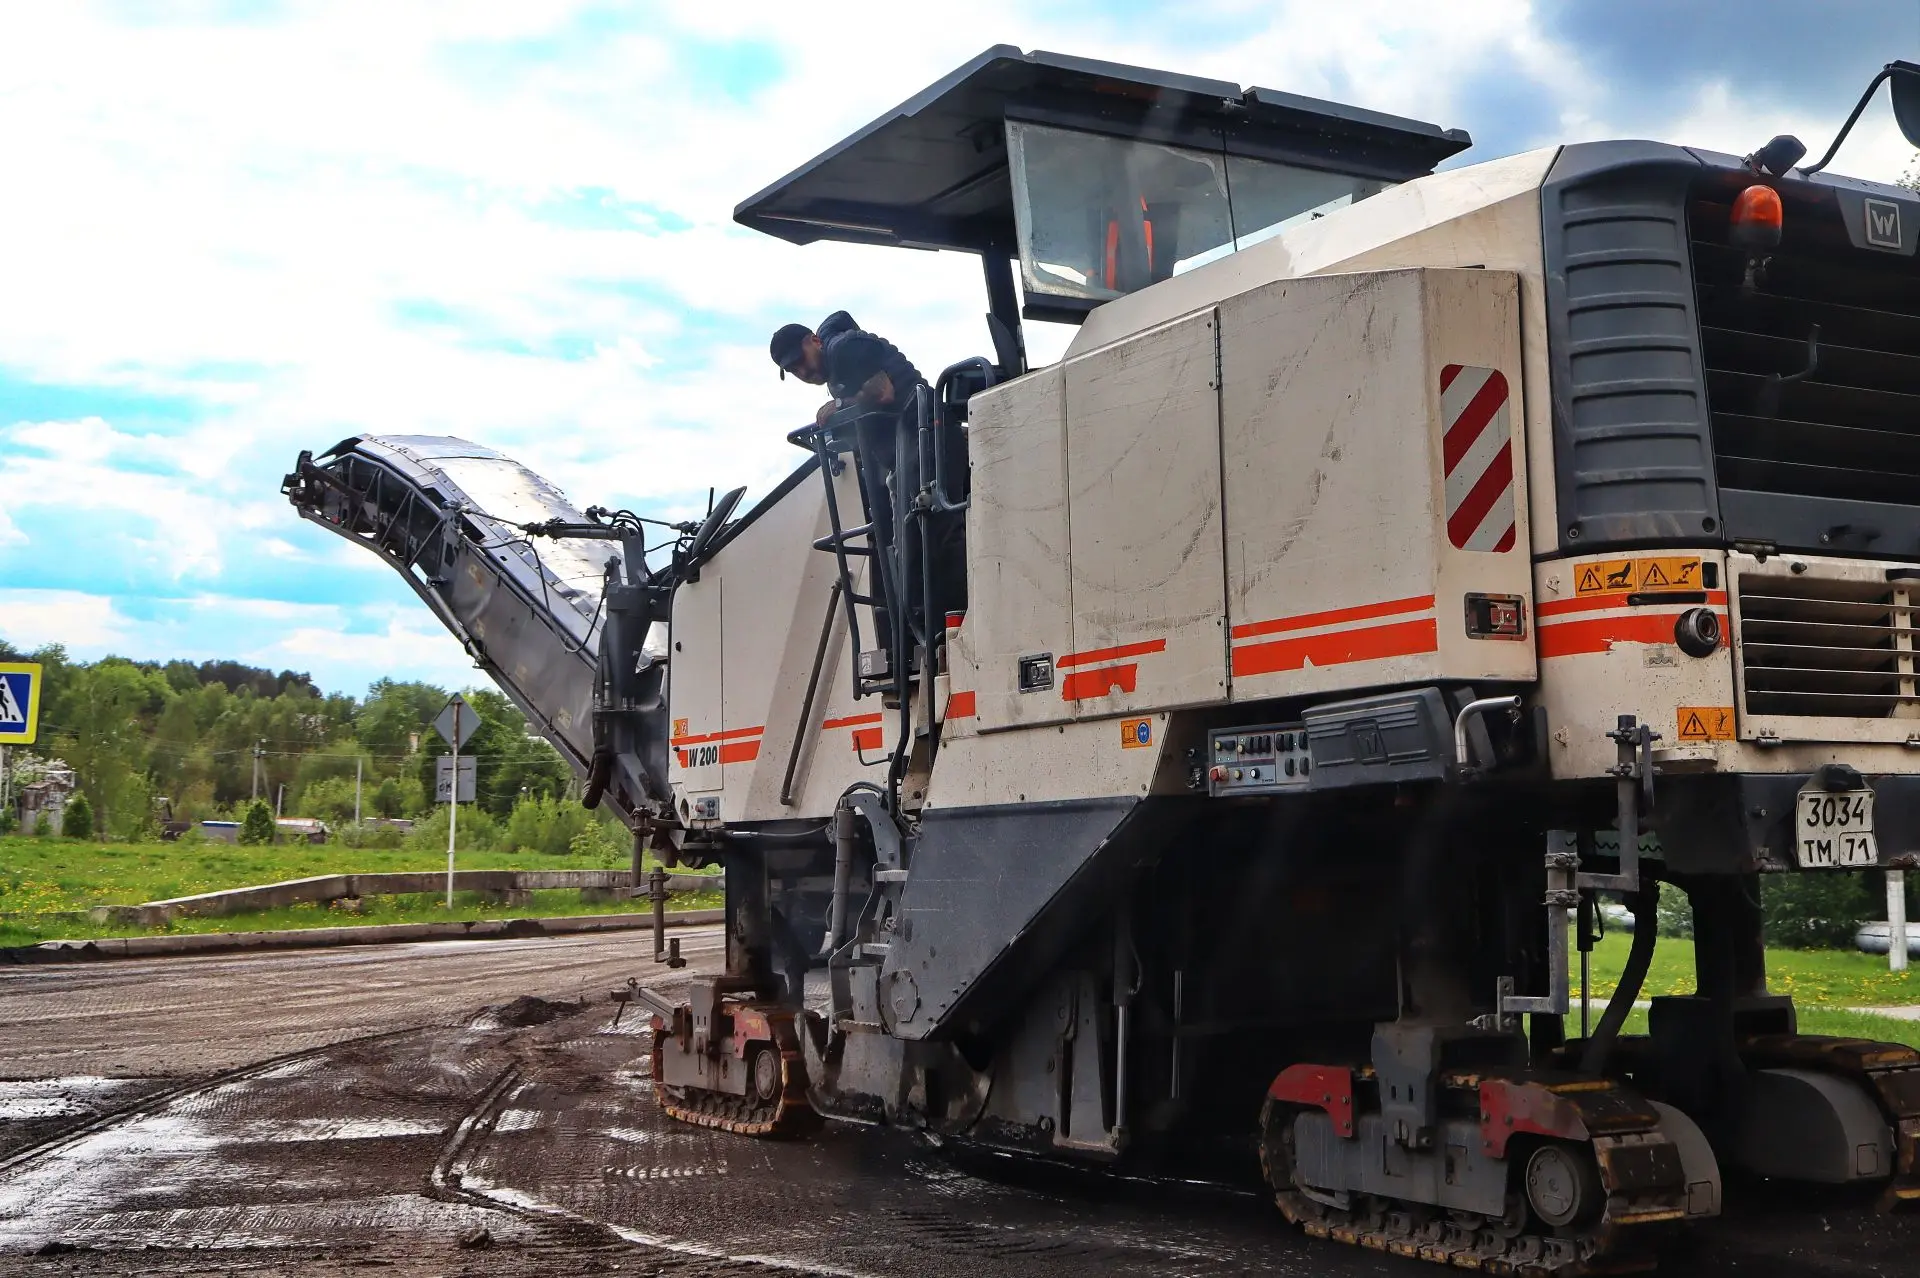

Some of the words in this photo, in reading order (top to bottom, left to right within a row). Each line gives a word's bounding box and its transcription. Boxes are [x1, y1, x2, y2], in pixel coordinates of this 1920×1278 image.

[689, 748, 698, 767] W
[699, 746, 718, 767] 200
[1806, 796, 1864, 826] 3034
[1845, 838, 1870, 861] 71
